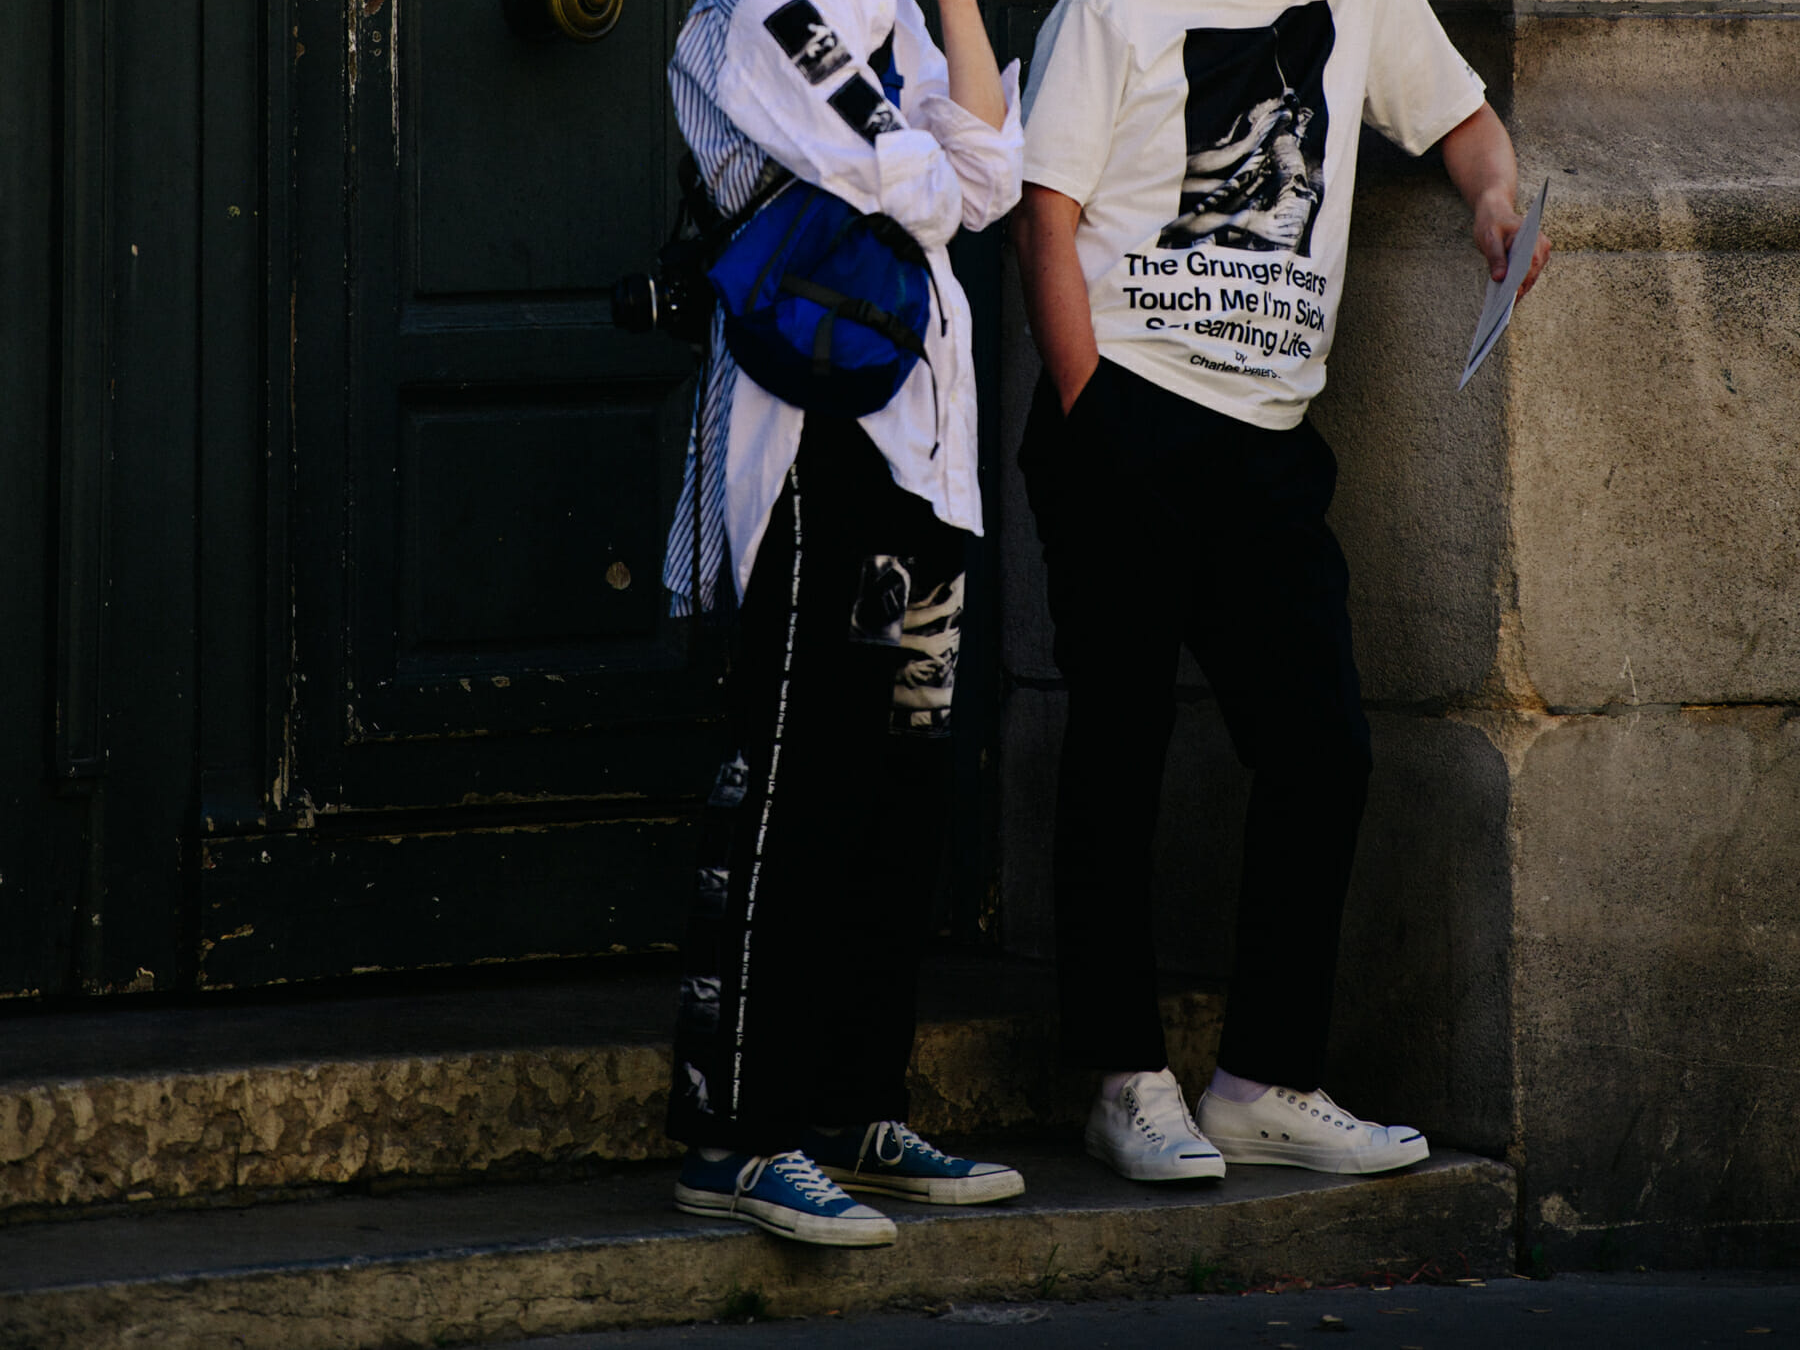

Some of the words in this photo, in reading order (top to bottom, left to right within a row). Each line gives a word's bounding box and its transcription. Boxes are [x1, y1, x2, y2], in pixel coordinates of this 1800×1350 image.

[1123, 253, 1178, 276] The
[1186, 250, 1282, 285] Grunge
[1285, 260, 1326, 297] Years
[1123, 287, 1211, 311] Touch
[1220, 289, 1258, 312] Me
[1263, 291, 1290, 321] I'm
[1295, 298, 1325, 332] Sick
[1278, 329, 1312, 360] Life
[1190, 354, 1240, 374] Charles
[787, 626, 795, 651] Grunge
[780, 701, 786, 711] Me
[753, 862, 761, 874] The
[749, 875, 759, 901] Grunge
[743, 951, 750, 962] Me
